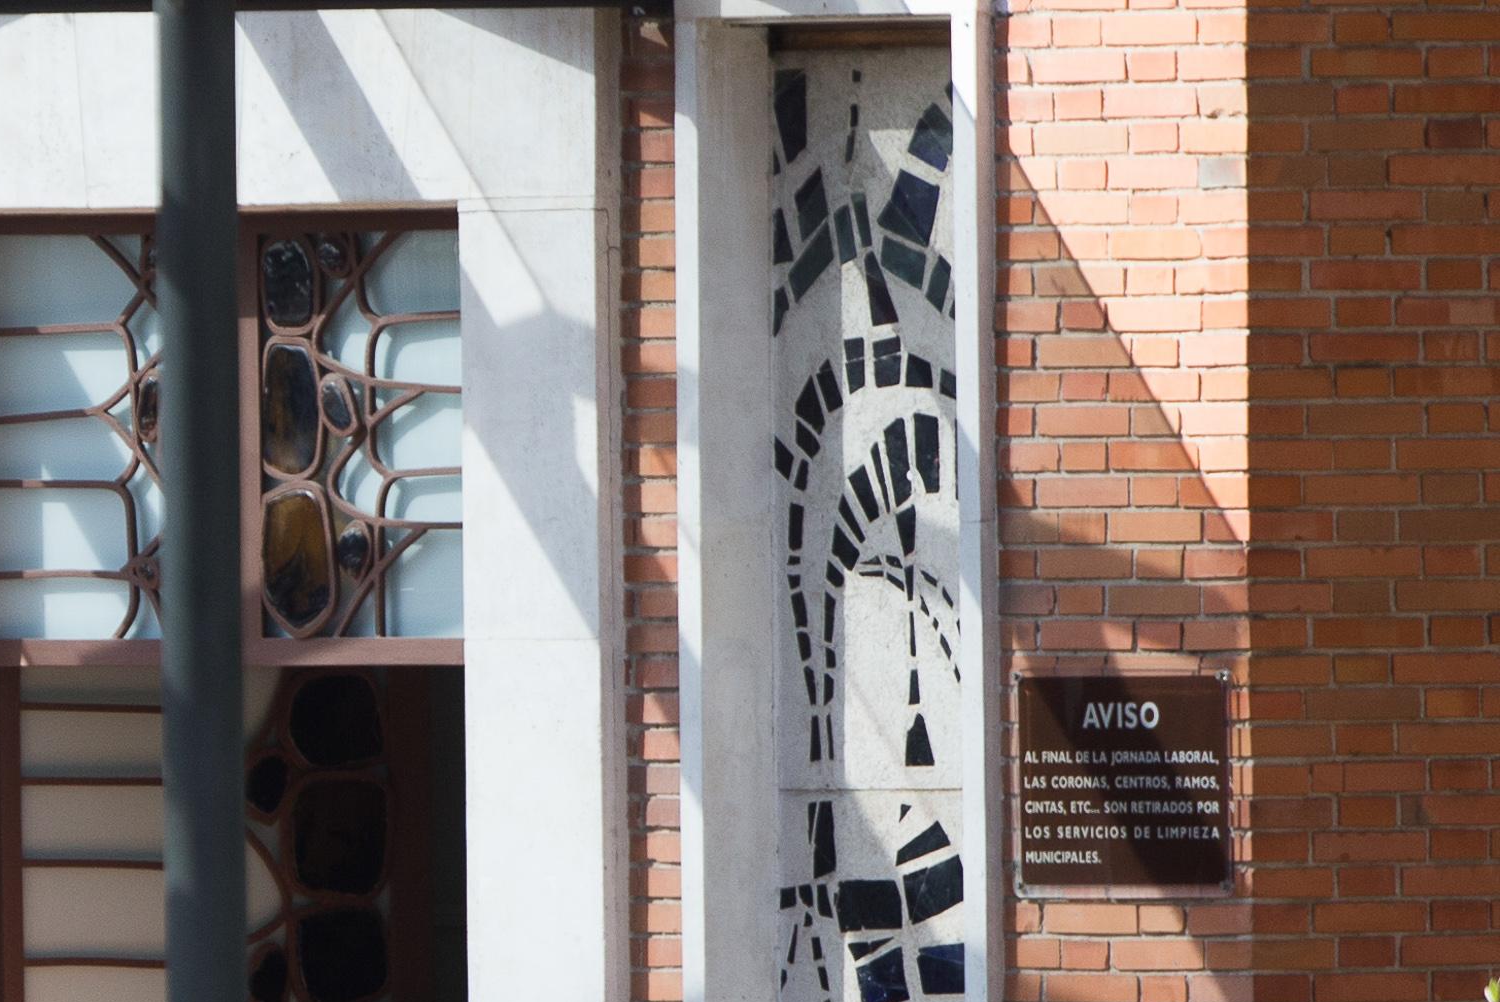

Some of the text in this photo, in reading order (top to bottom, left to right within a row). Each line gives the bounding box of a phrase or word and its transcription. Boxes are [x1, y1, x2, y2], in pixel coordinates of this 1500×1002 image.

[1083, 702, 1160, 729] AVISO
[1024, 750, 1219, 766] AL FINAL DE LA JORNADA LABORAL,
[1024, 776, 1219, 790] LAS CORONAS, CENTROS, RAMOS,
[1025, 801, 1067, 815] CINTAS,
[1104, 801, 1128, 814] SON
[1130, 801, 1193, 814] RETIRADOS
[1197, 801, 1219, 814] POR
[1025, 826, 1220, 839] LOS SERVICIOS DE LIMPIEZA
[1025, 851, 1101, 864] MUNICIPALES.
